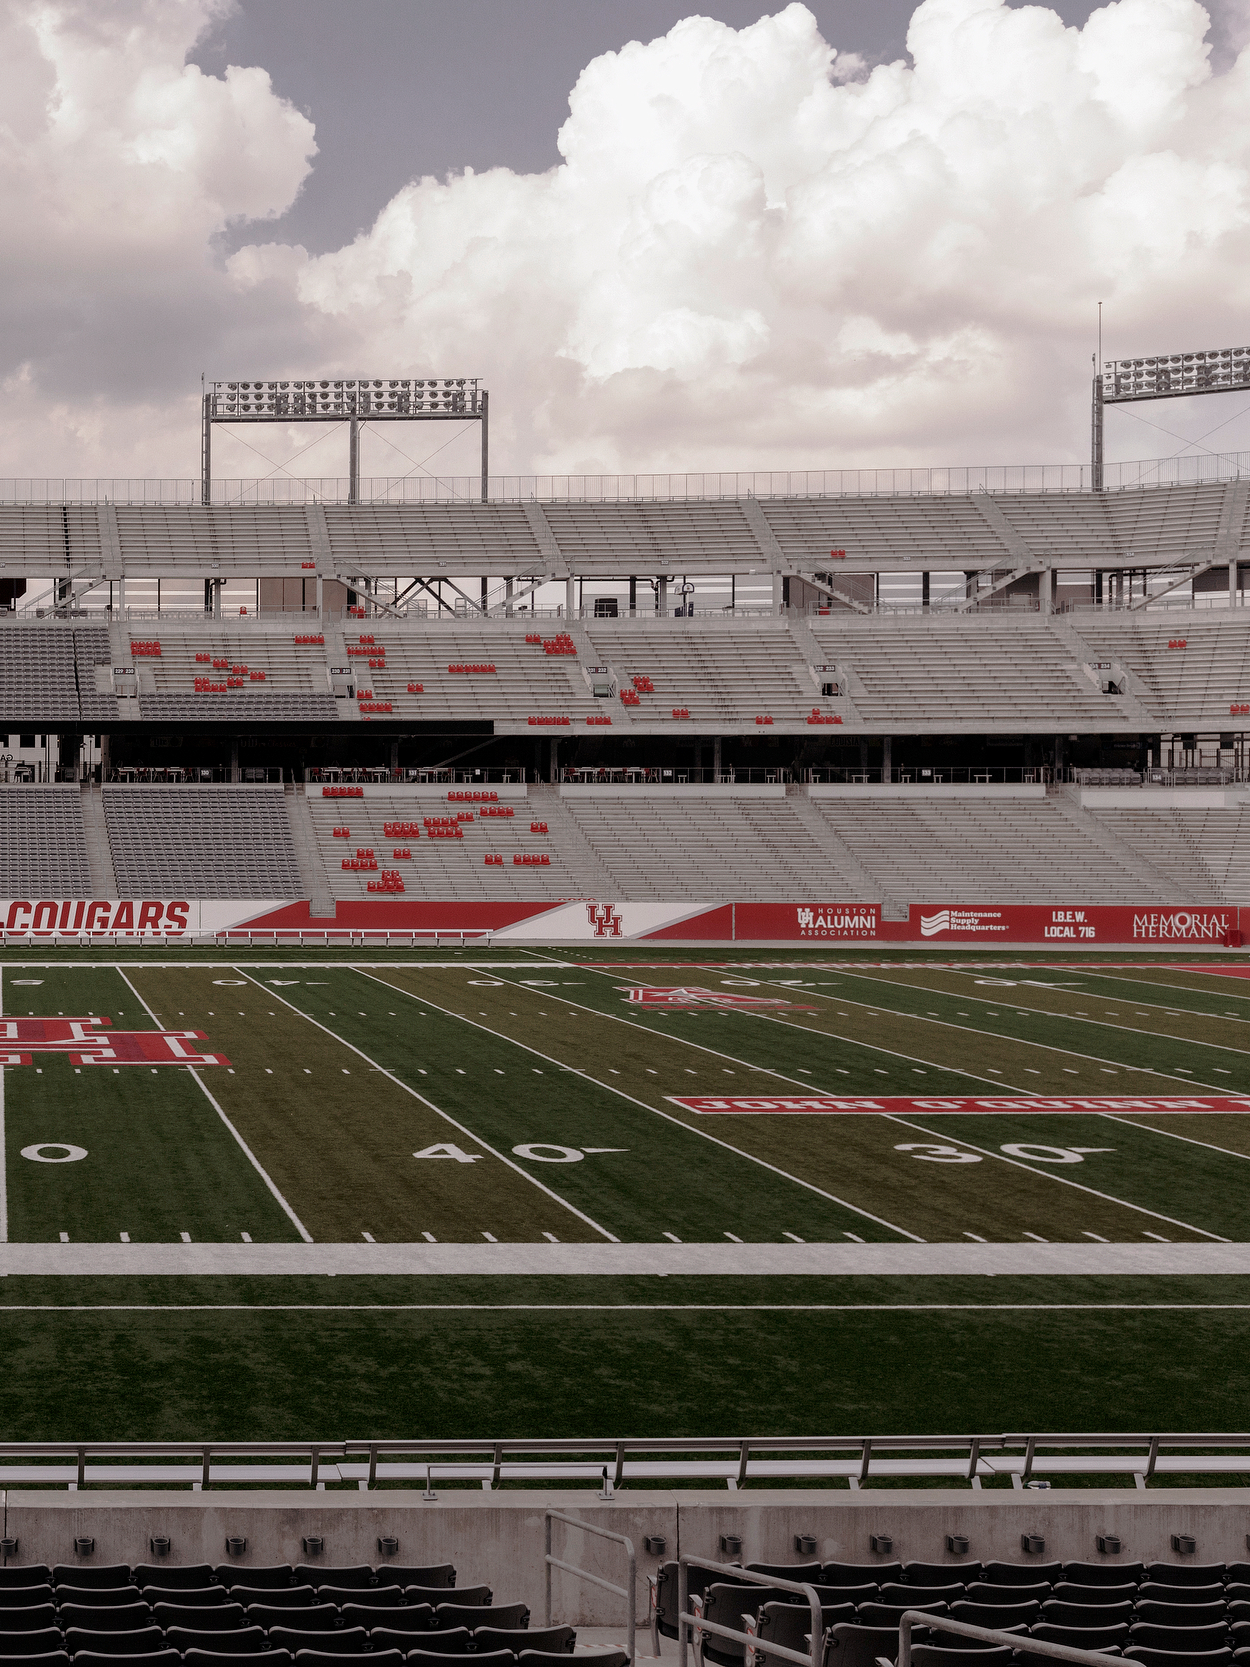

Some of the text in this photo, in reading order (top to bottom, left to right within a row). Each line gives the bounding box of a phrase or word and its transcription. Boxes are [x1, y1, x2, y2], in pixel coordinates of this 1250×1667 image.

[5, 901, 190, 936] COUGARS
[814, 916, 876, 928] ALUMNI
[1052, 911, 1088, 923] I.B.E.W.
[1133, 912, 1230, 929] MEMORIAL
[1044, 926, 1096, 938] LOCAL 716
[1133, 926, 1227, 938] HERMANN
[694, 1100, 1215, 1110] JOHN O'QUINN
